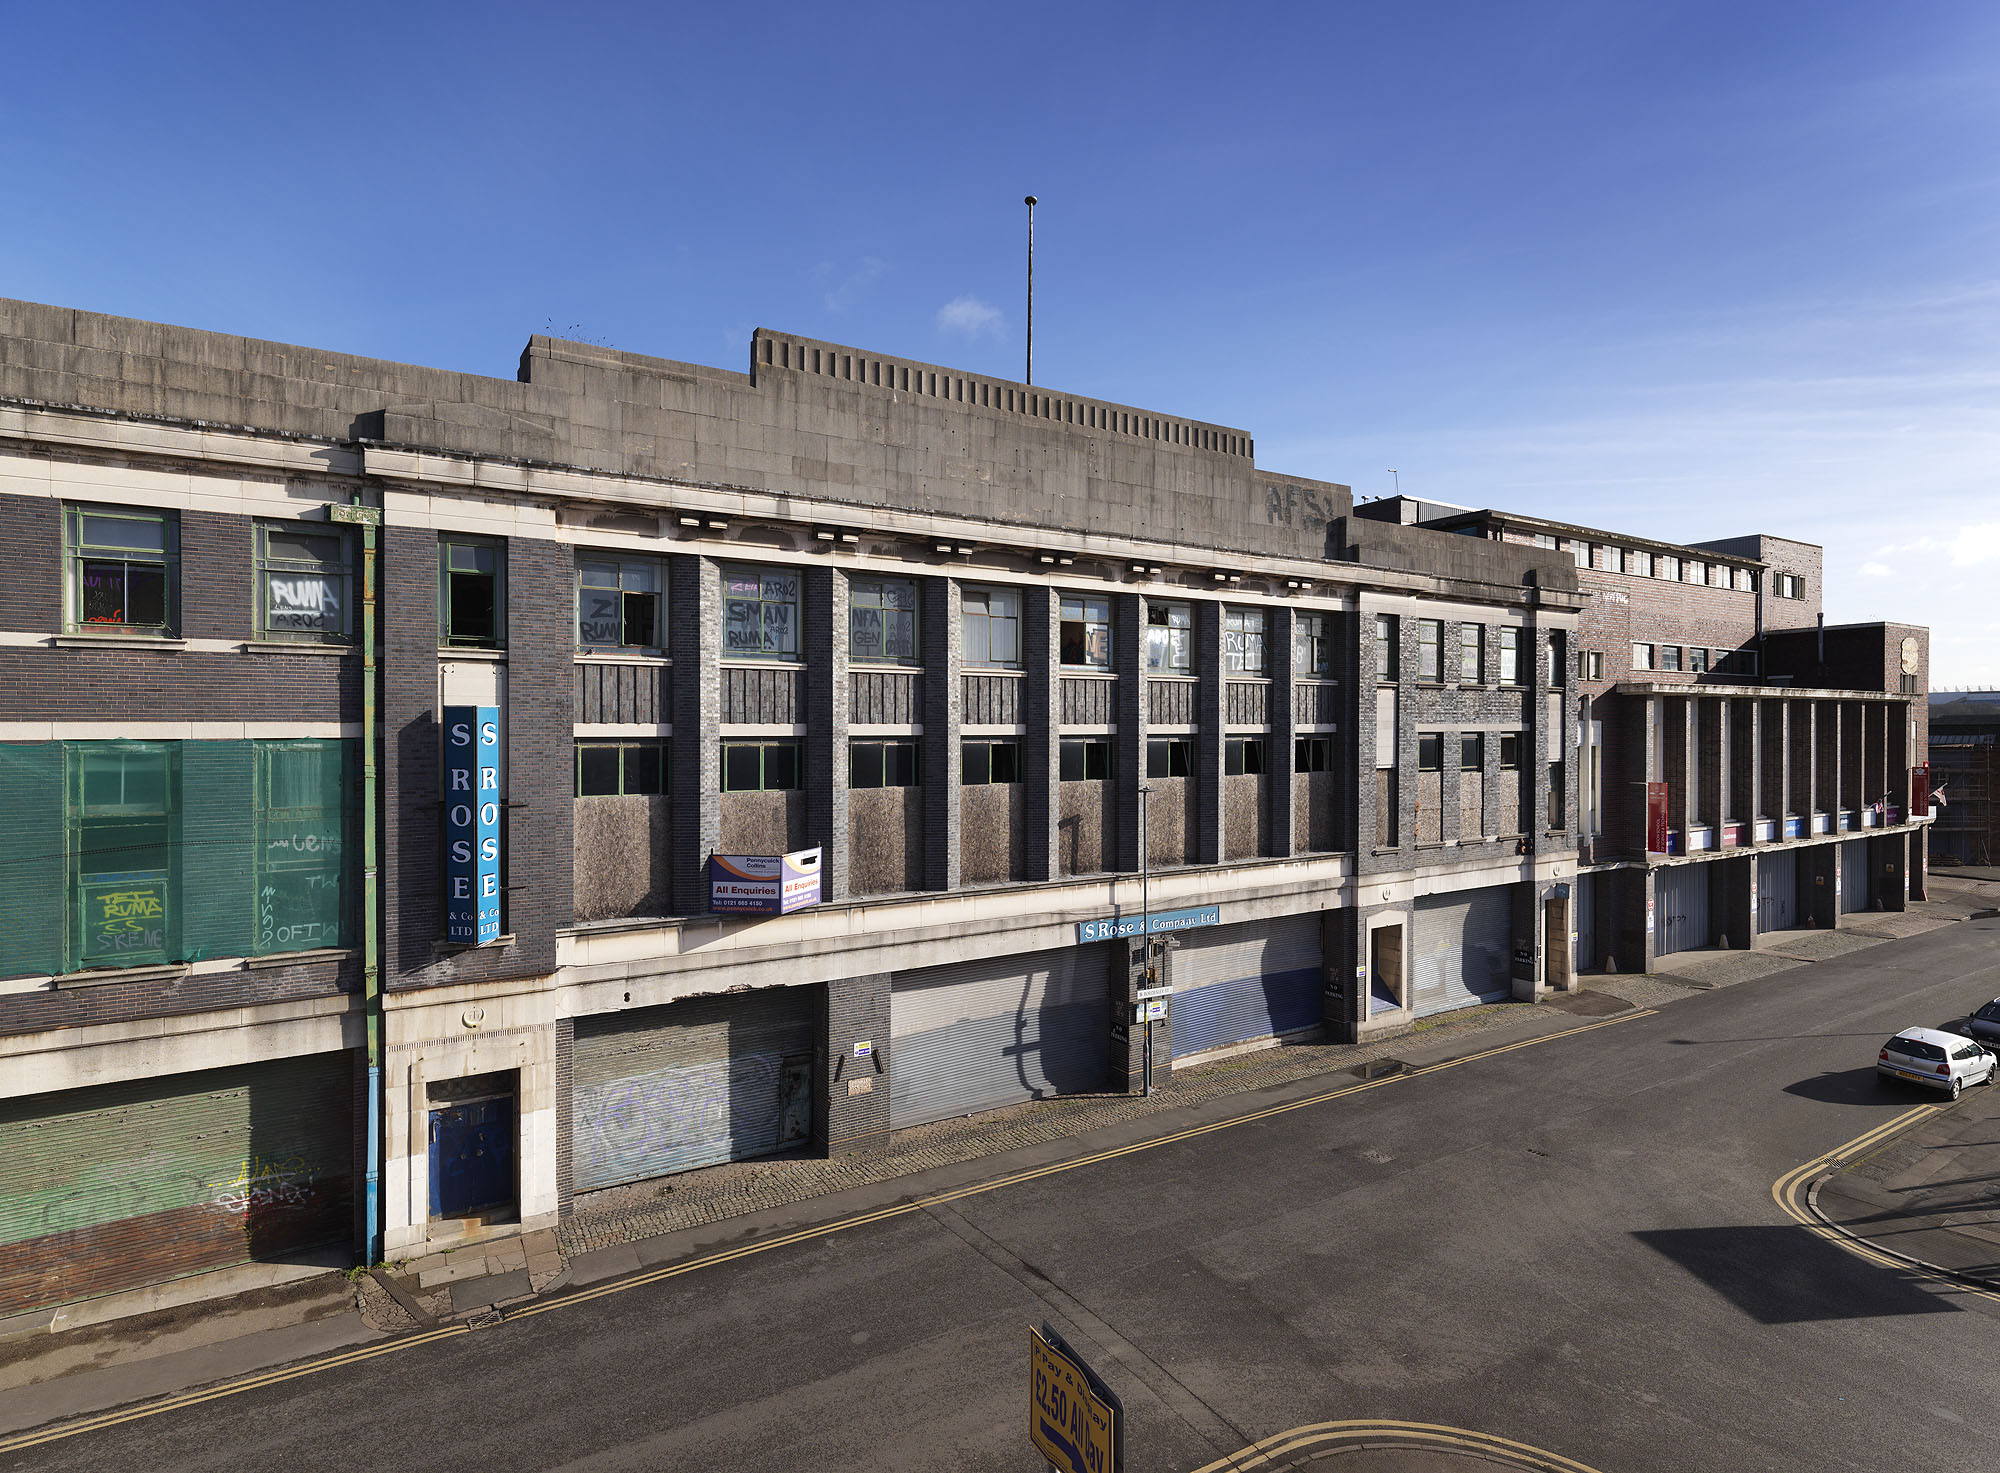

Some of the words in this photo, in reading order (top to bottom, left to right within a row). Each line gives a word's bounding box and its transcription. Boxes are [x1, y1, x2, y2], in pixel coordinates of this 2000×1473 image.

[451, 723, 470, 746] S
[481, 722, 497, 746] S
[450, 768, 472, 899] ROSE
[480, 766, 498, 898] ROSE
[716, 886, 728, 894] All
[731, 887, 776, 896] Enquiries
[785, 885, 793, 893] All
[794, 879, 818, 891] Enquiries
[461, 911, 473, 921] Co
[488, 907, 499, 917] Co
[450, 926, 473, 936] LTD
[480, 921, 499, 936] LTD
[1084, 924, 1095, 938] S
[1098, 922, 1134, 937] Rose
[1152, 916, 1197, 930] Company
[1200, 912, 1216, 923] Ltd
[1042, 1356, 1061, 1377] Pay
[1066, 1372, 1073, 1386] &
[1036, 1368, 1067, 1427] £2.50
[1070, 1400, 1083, 1449] All
[1085, 1419, 1104, 1473] Day
